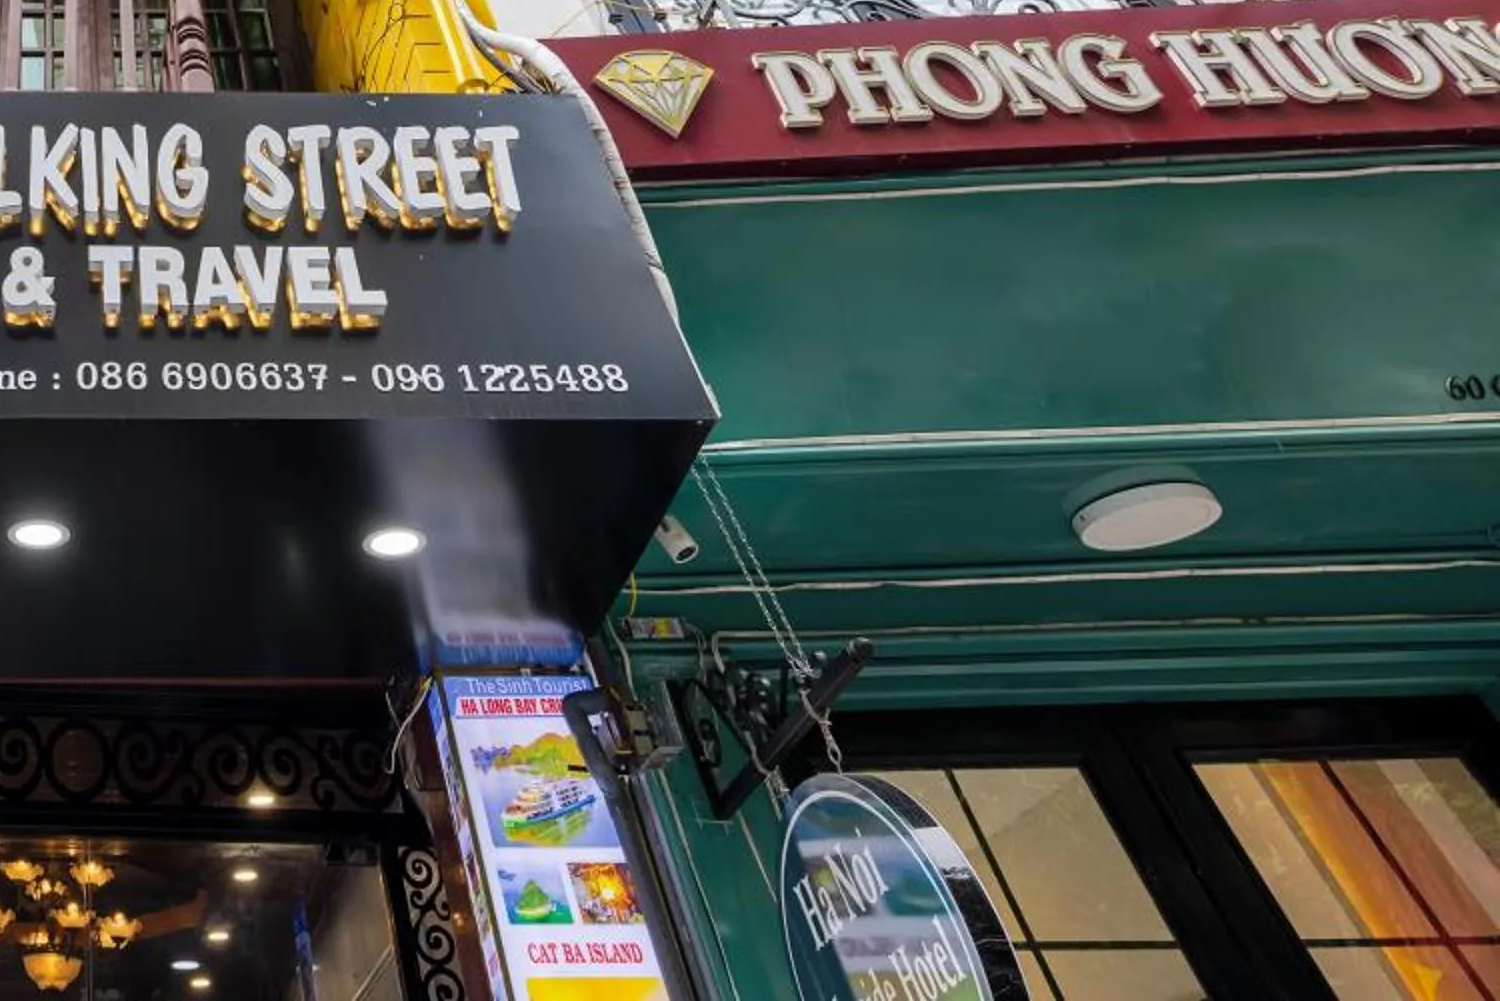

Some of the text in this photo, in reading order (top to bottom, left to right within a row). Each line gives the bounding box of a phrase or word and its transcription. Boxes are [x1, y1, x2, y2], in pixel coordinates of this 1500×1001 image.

[751, 33, 1164, 129] PHONG
[243, 123, 522, 229] STREET
[2, 245, 57, 323] &
[87, 245, 388, 323] TRAVEL
[75, 362, 148, 391] 086
[161, 362, 329, 391] 6906637
[371, 363, 446, 392] 096
[457, 363, 630, 392] 1225488
[1443, 374, 1487, 401] 60
[467, 677, 588, 695] The Sinh Tourist
[460, 697, 477, 716] HA
[480, 697, 514, 715] LONG
[515, 697, 538, 715] BAY
[526, 942, 644, 964] CAT BA ISLAND
